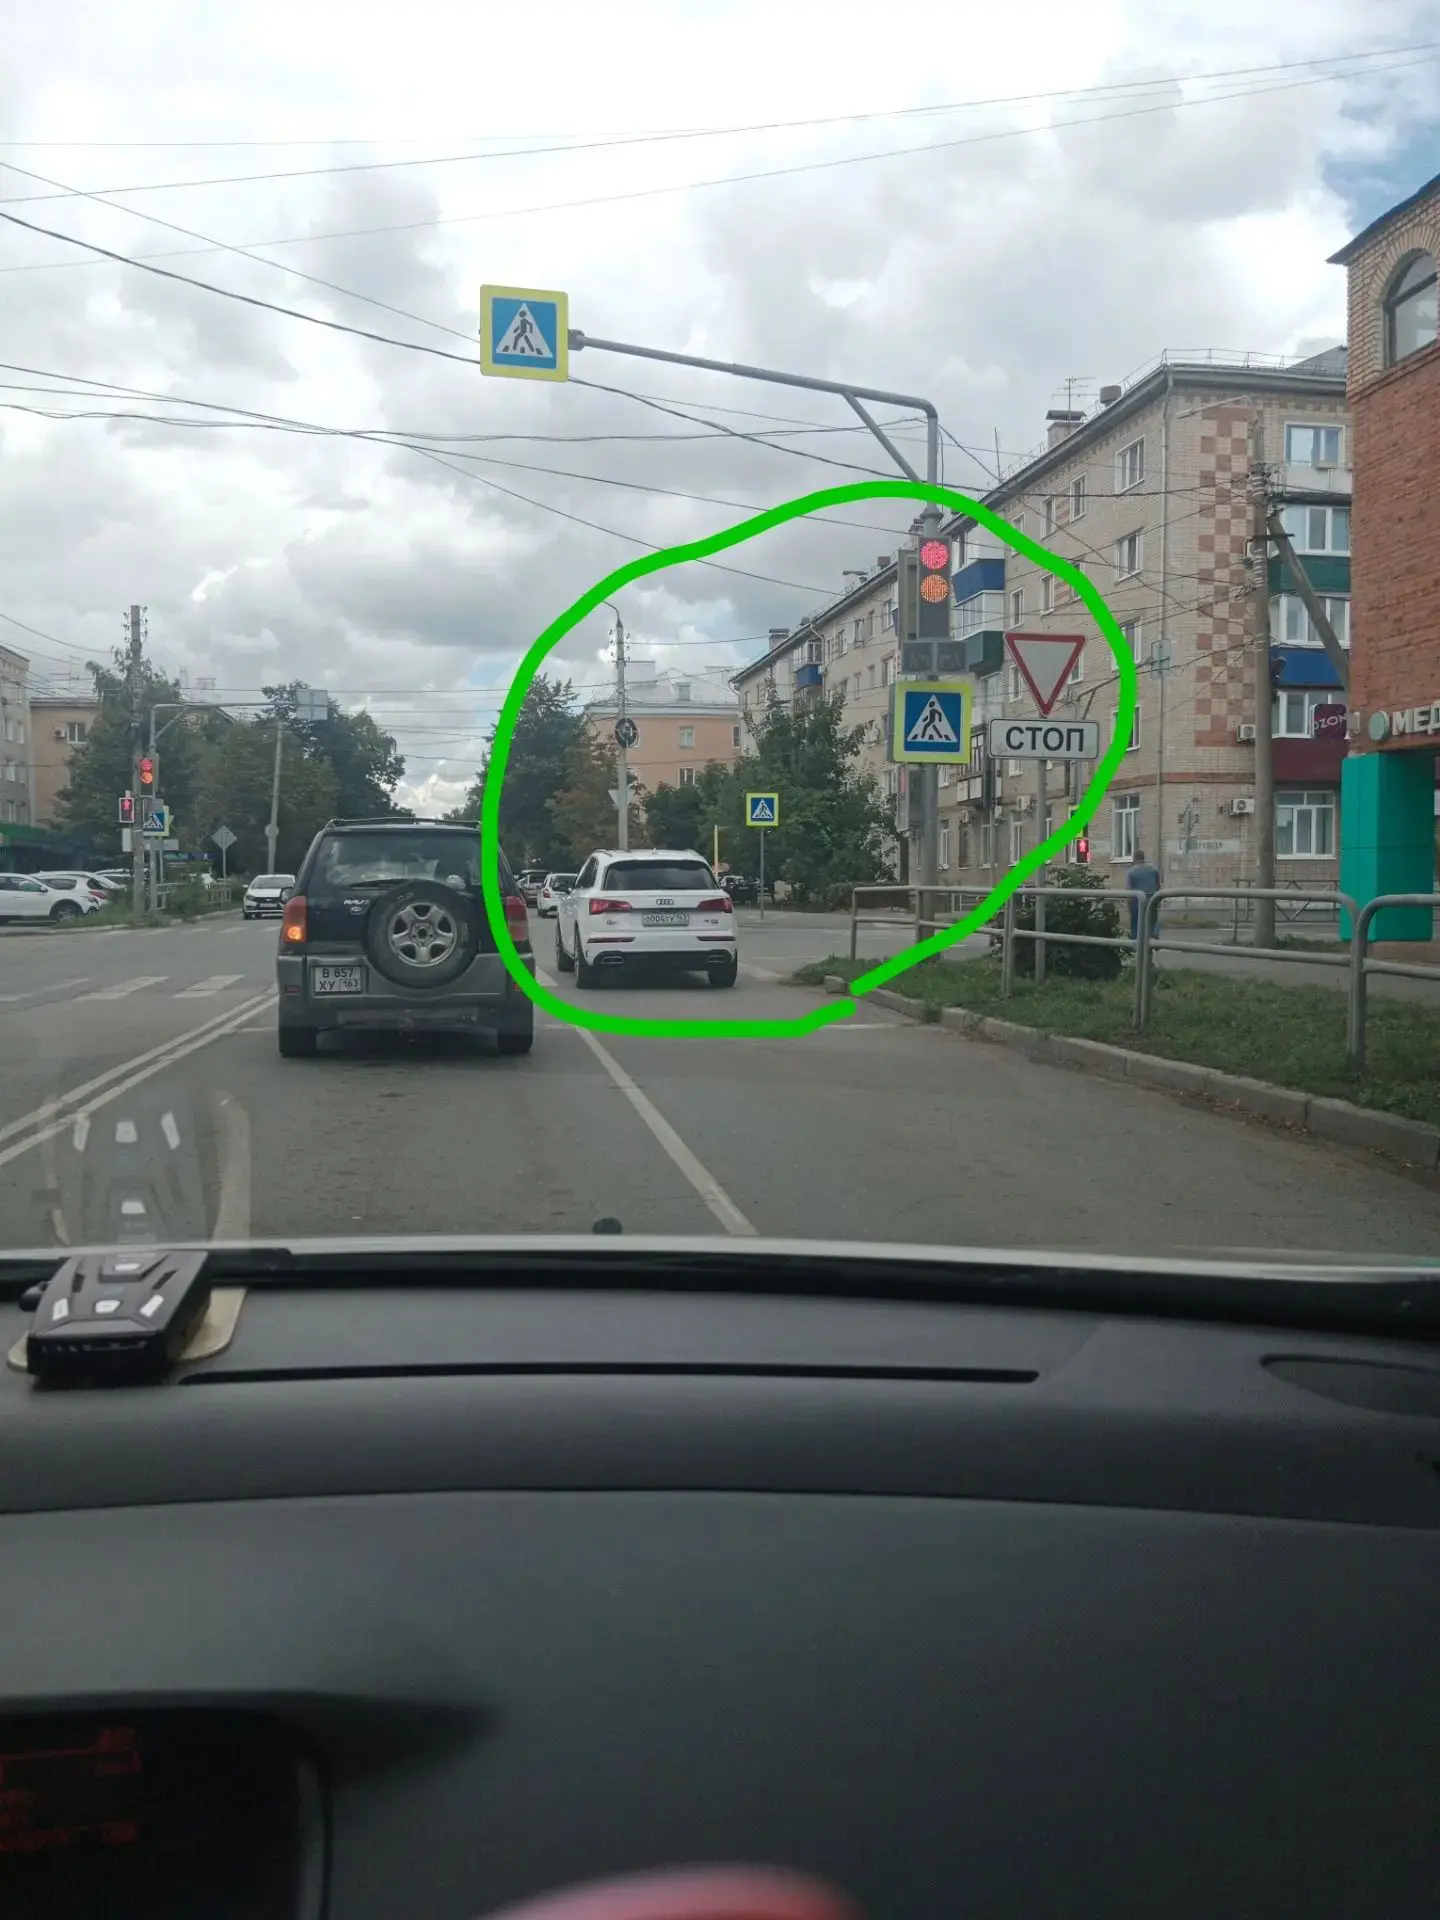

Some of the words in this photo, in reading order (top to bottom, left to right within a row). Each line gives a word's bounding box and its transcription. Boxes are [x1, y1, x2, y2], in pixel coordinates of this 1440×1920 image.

[1005, 726, 1084, 752] СТОП
[334, 967, 354, 978] 857
[342, 979, 358, 988] 163
